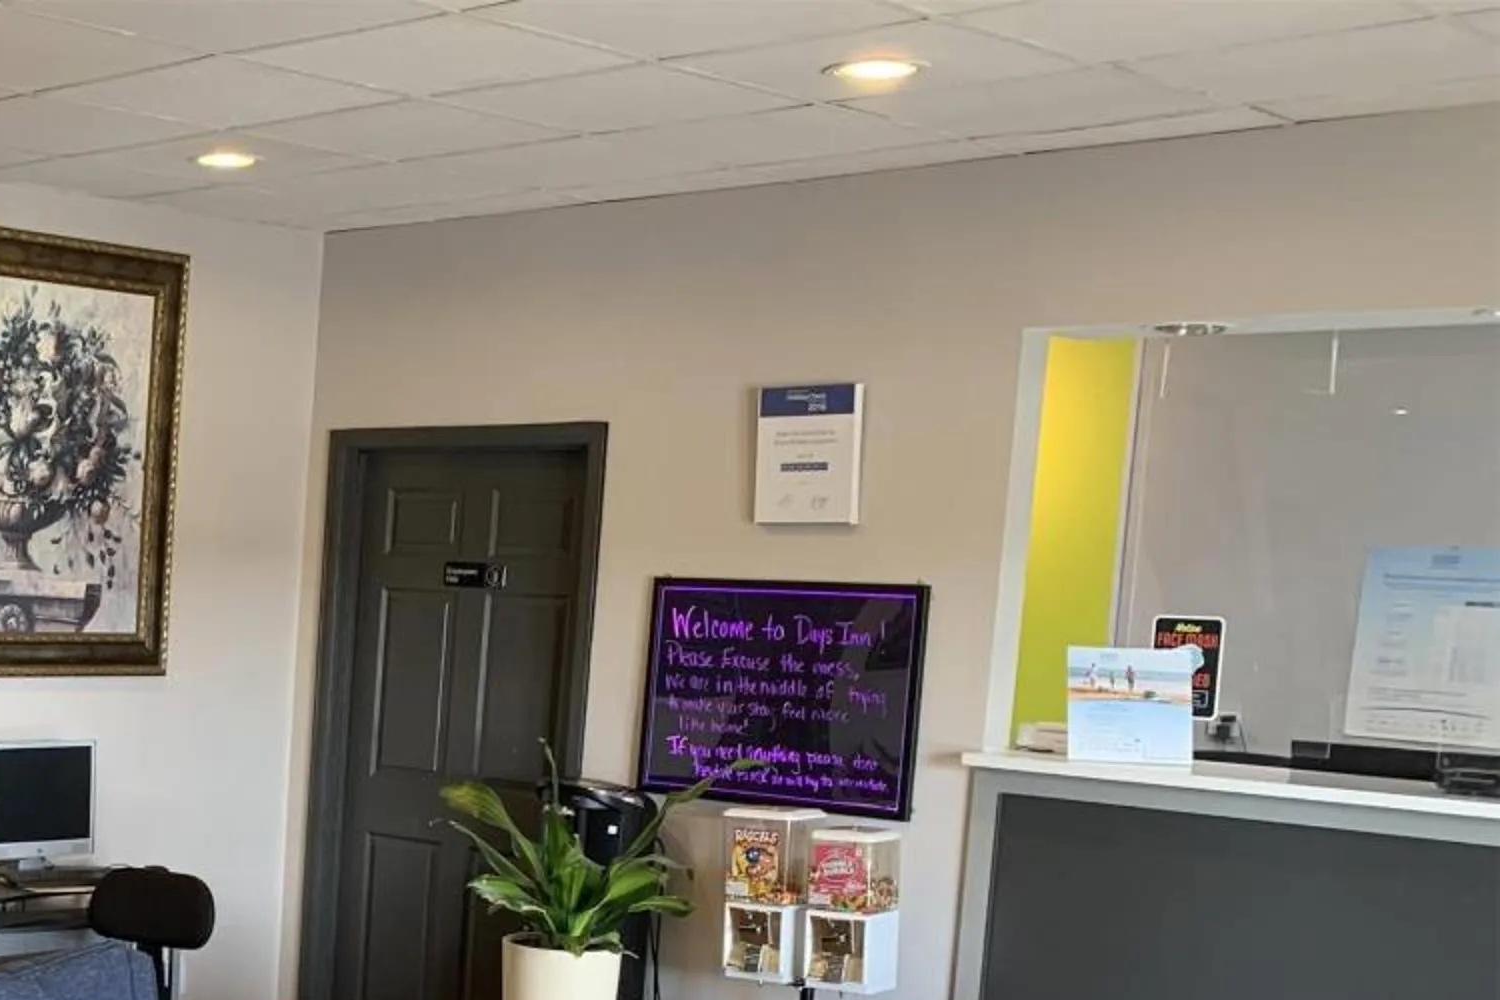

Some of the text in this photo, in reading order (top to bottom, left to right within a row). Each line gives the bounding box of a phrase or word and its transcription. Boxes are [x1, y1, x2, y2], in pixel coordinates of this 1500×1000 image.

[672, 605, 754, 641] Welcome
[762, 613, 785, 641] to
[793, 614, 834, 655] Days
[665, 639, 715, 667] Please
[780, 652, 805, 673] the
